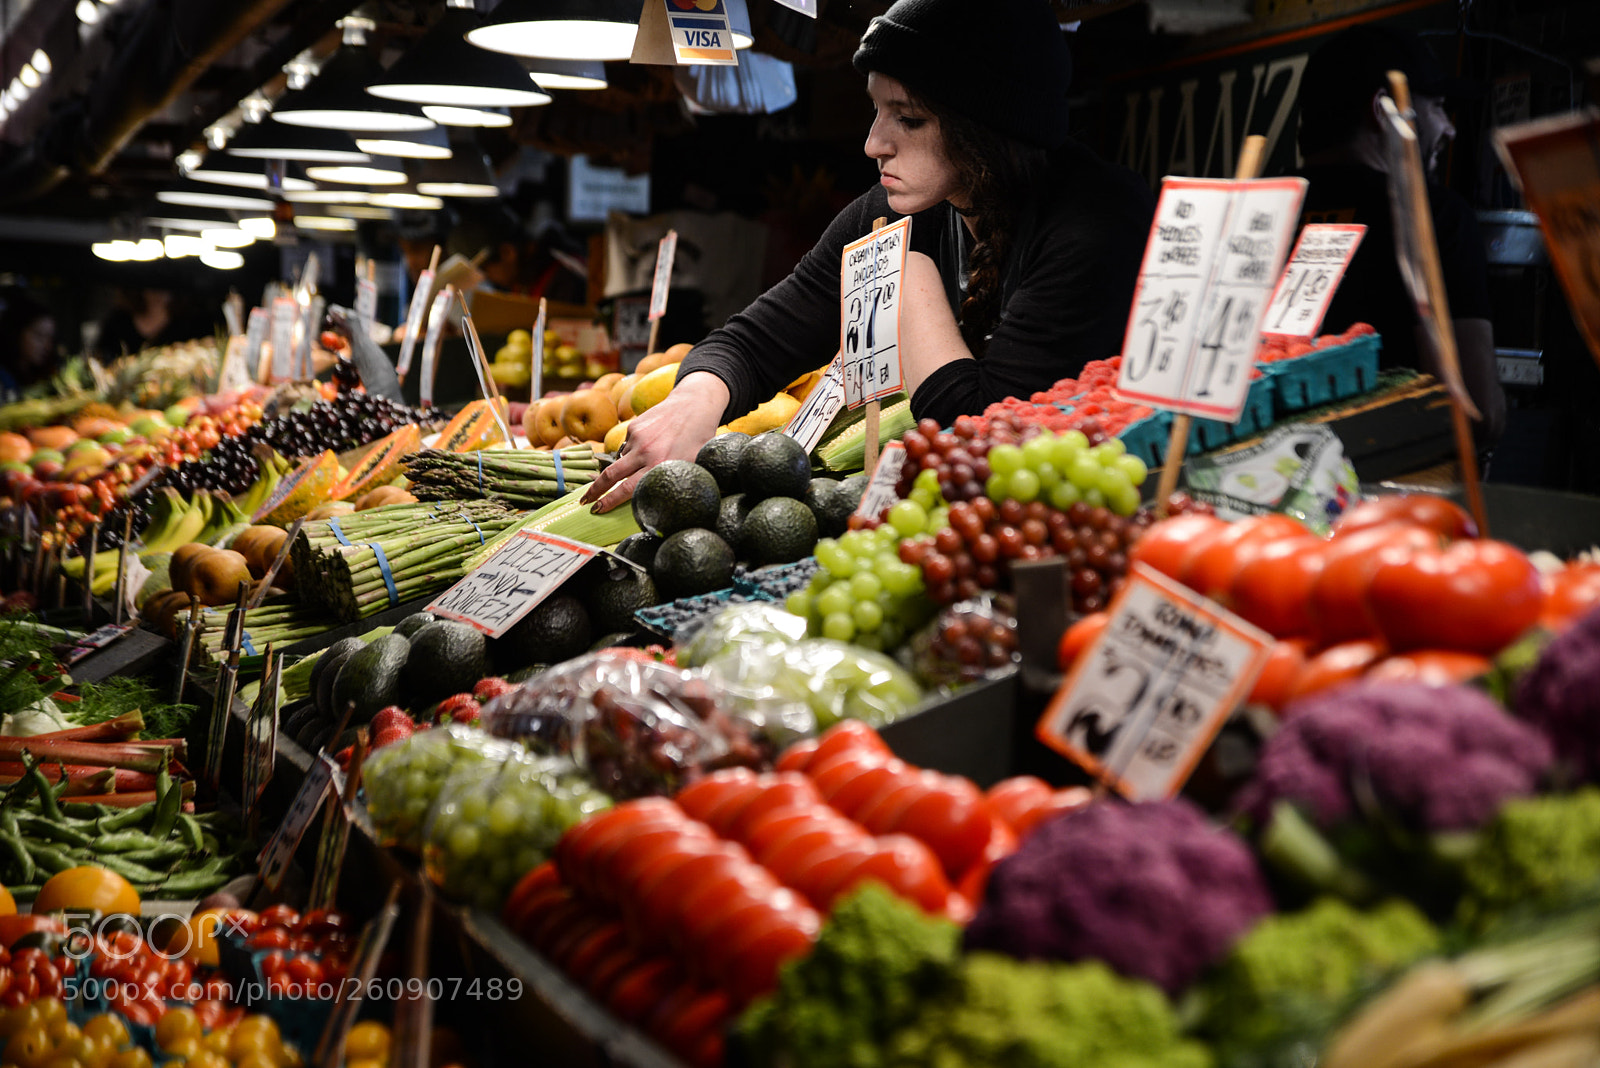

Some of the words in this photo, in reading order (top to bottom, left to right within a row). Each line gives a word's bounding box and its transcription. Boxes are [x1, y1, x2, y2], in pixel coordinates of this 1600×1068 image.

[684, 30, 721, 48] VISA
[1116, 52, 1310, 191] MANZ
[853, 256, 889, 287] AVOCADOS
[490, 533, 582, 578] PLEEZA
[486, 572, 519, 597] NO
[438, 581, 528, 628] SQUEEZA
